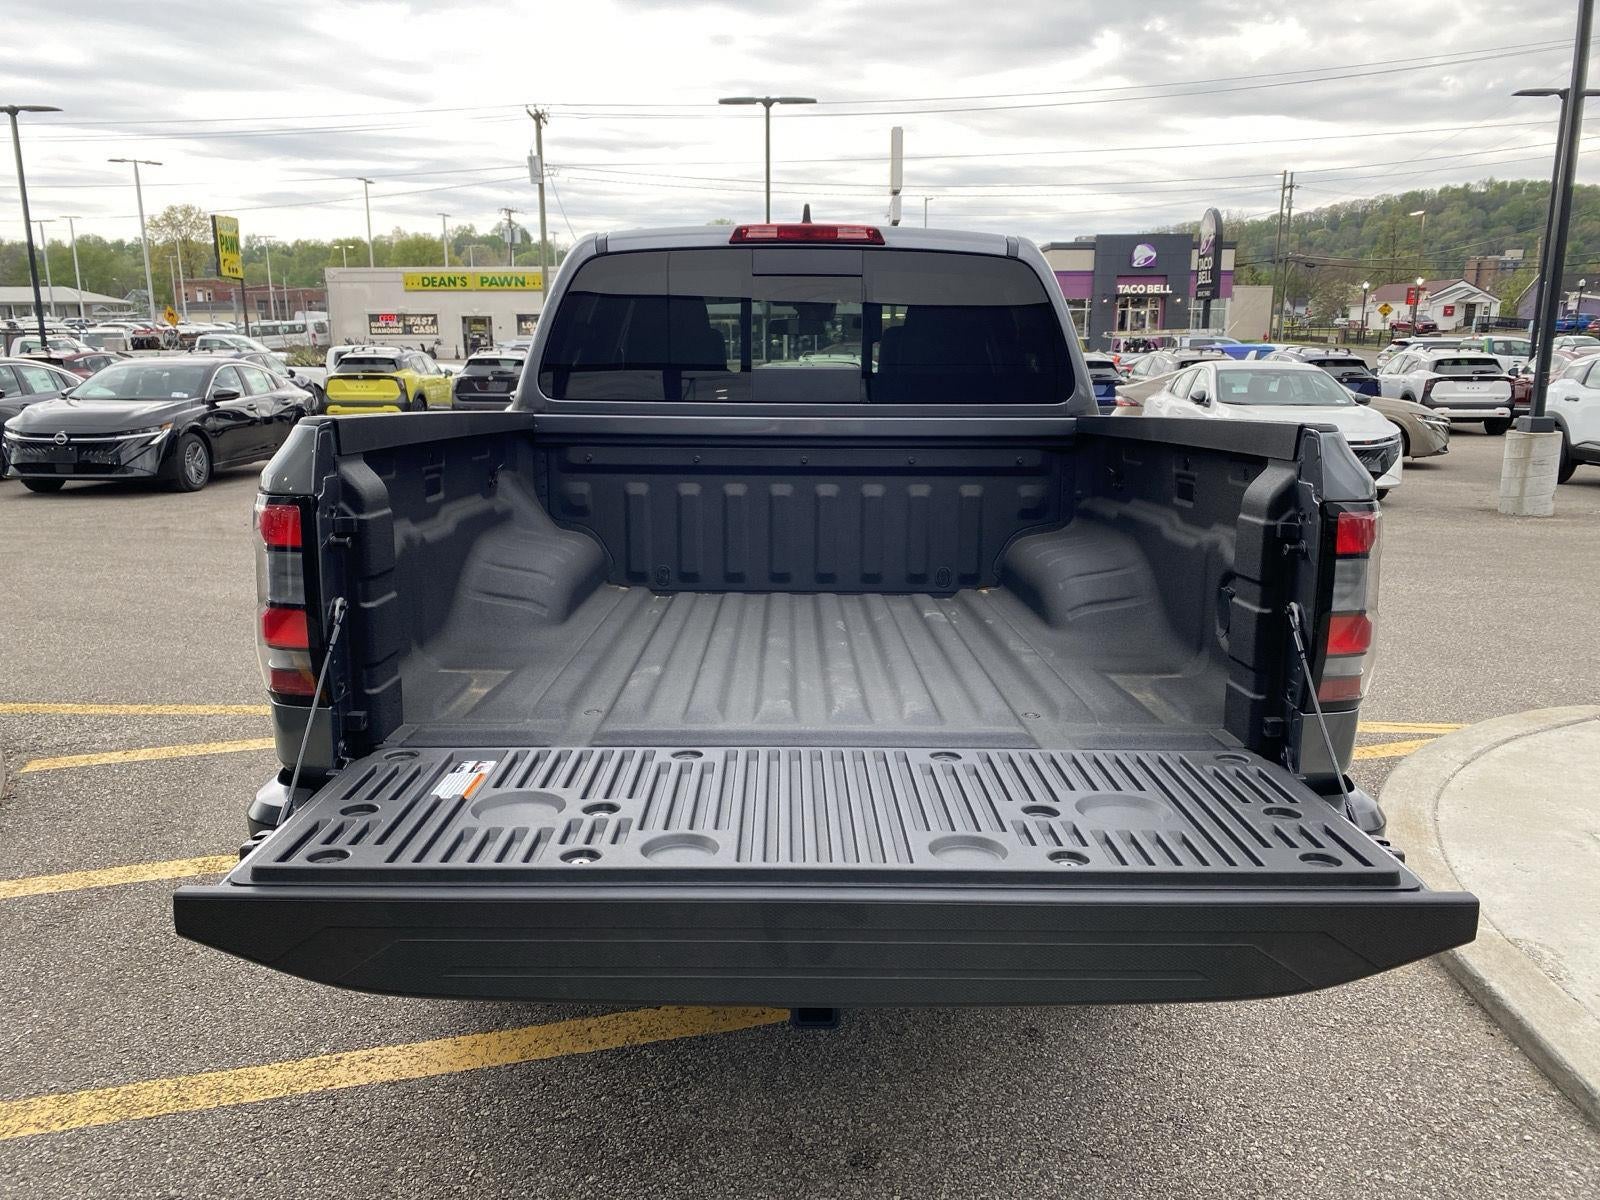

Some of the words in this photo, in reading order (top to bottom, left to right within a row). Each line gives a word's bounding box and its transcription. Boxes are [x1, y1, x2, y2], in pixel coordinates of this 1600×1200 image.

[219, 233, 240, 255] PAWN
[1198, 257, 1213, 270] TACO
[421, 276, 468, 287] DEAN'S
[480, 276, 526, 287] PAWN
[1197, 270, 1212, 285] BELL
[1117, 284, 1146, 294] TACO
[1147, 284, 1173, 294] BELL
[410, 316, 434, 325] FAST
[521, 321, 538, 329] LOA
[412, 325, 438, 334] CASH
